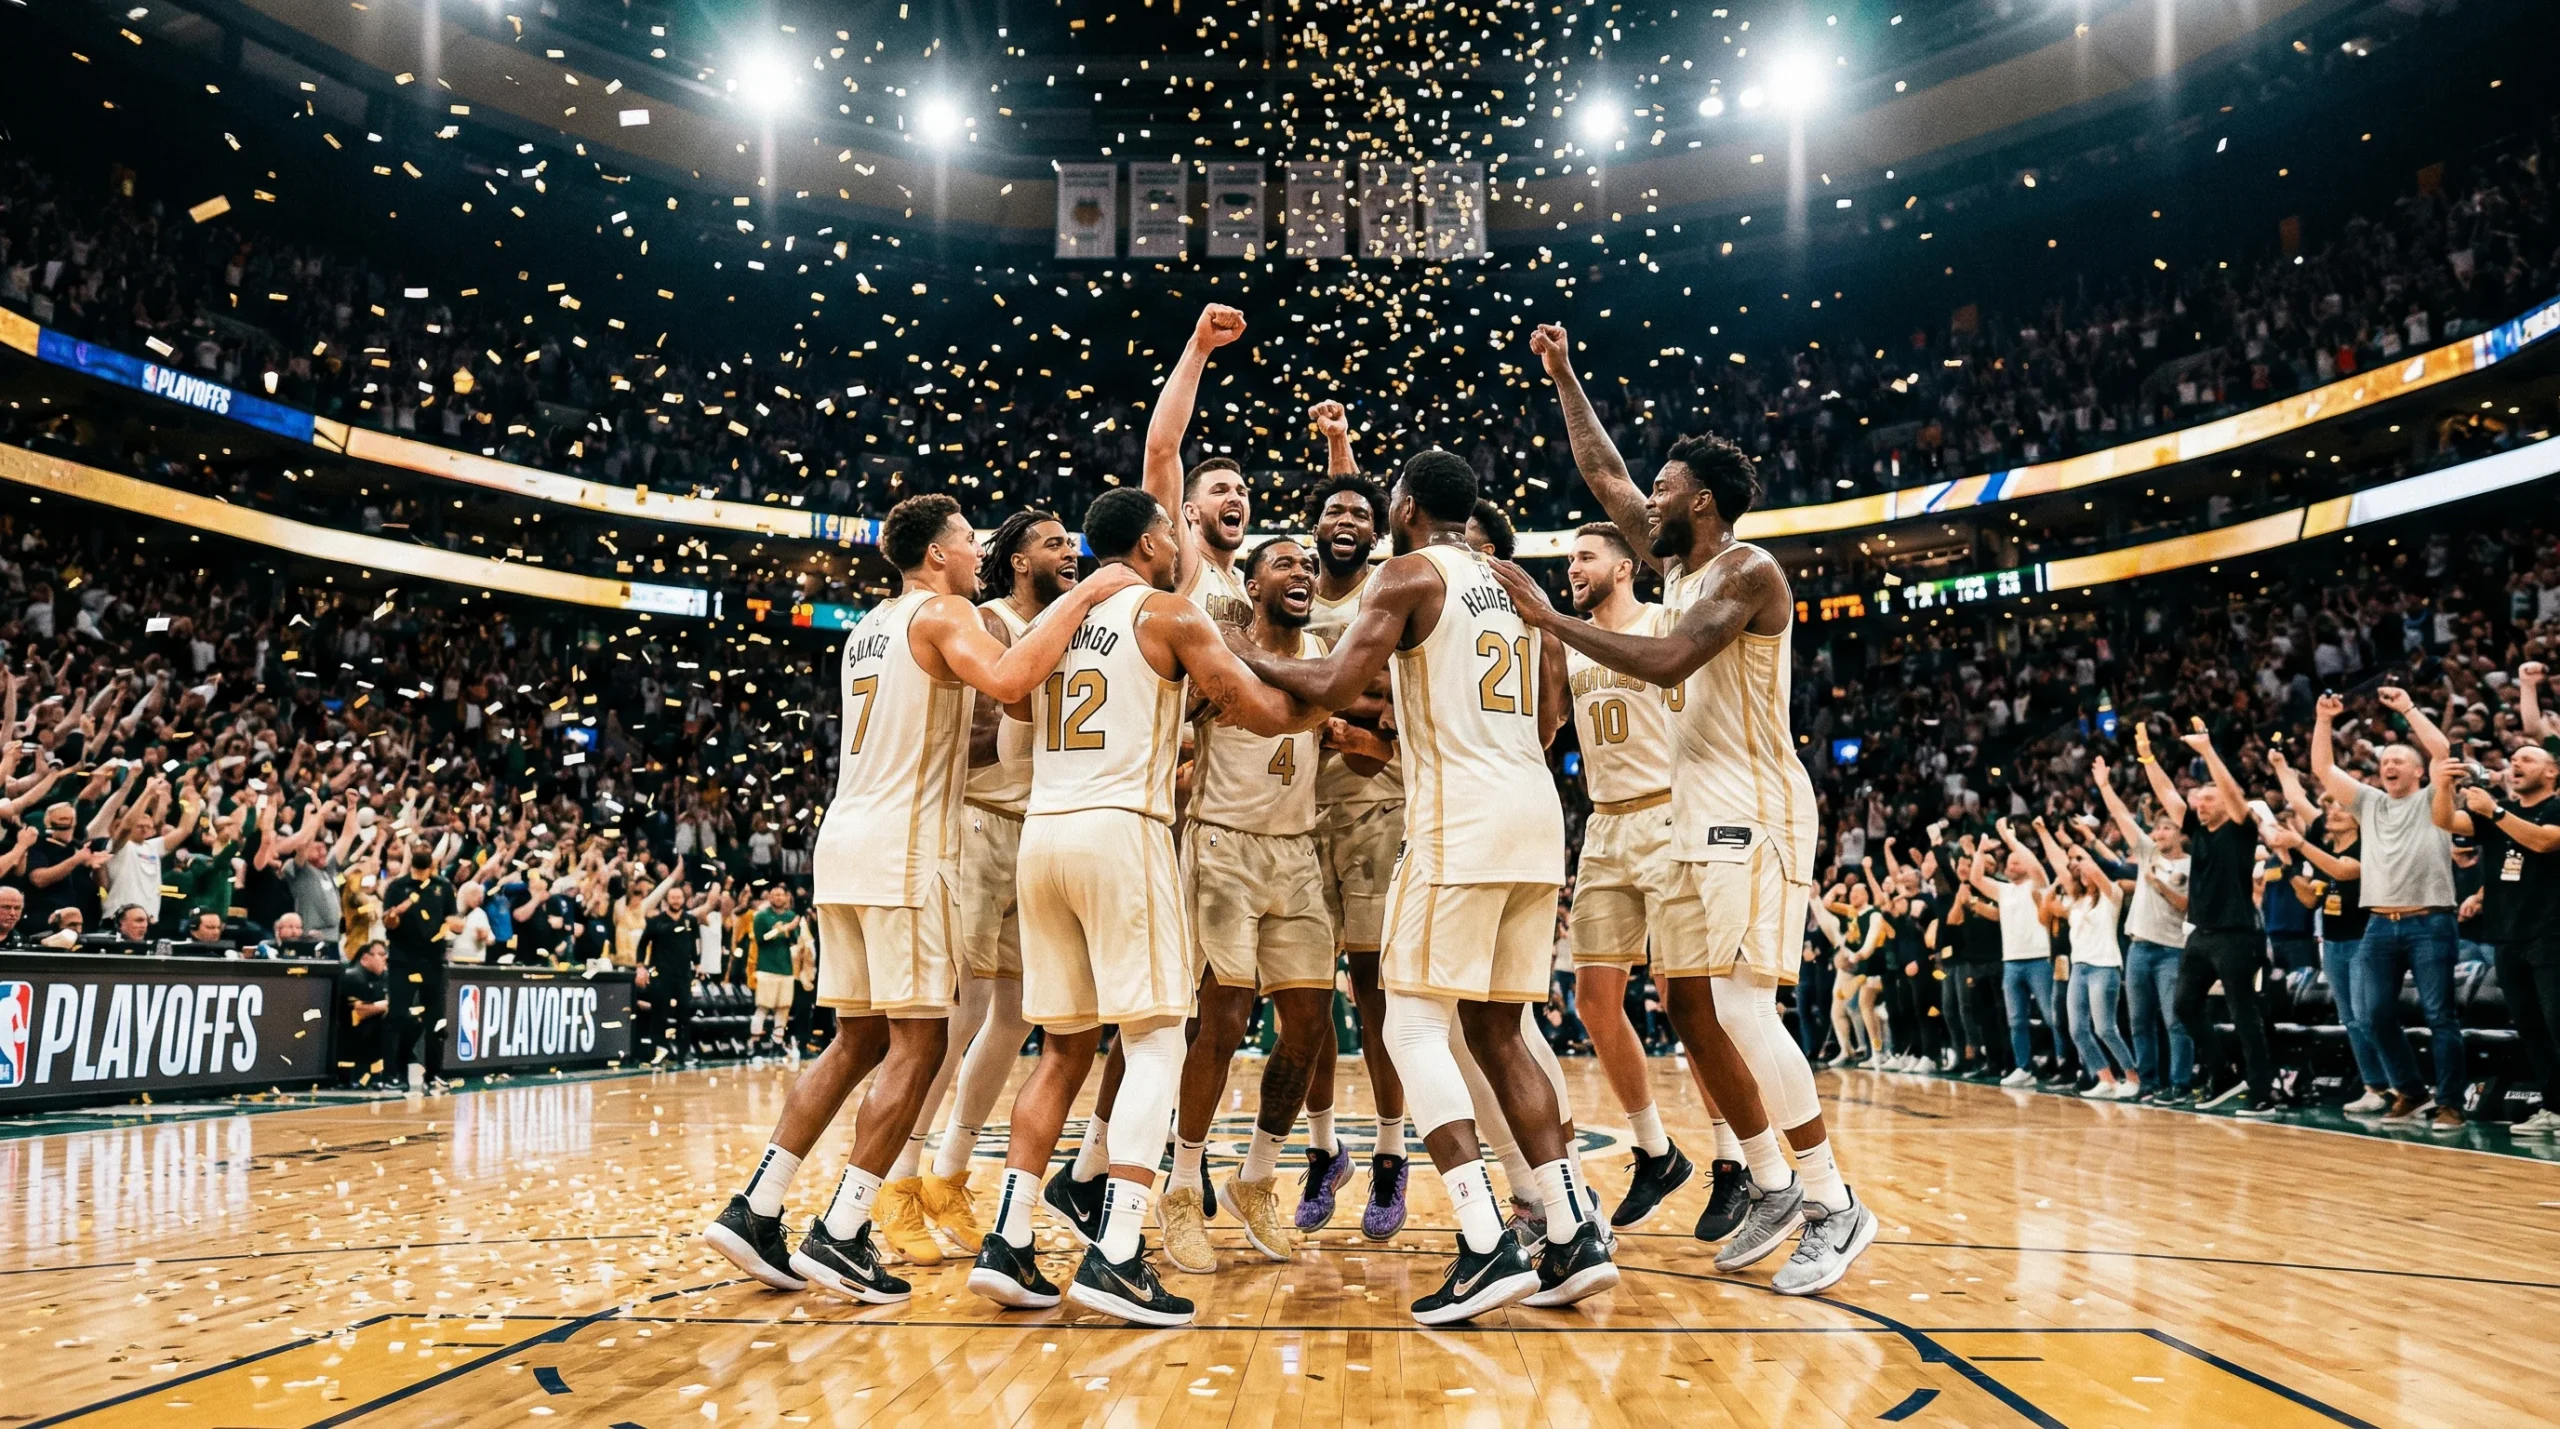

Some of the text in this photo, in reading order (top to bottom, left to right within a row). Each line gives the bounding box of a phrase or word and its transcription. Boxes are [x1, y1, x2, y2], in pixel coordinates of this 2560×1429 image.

[155, 367, 232, 415] PLAYOFFS
[1066, 624, 1119, 657] ONGO
[1475, 629, 1534, 717] 21
[850, 673, 879, 755] 7
[1045, 668, 1108, 752] 12
[1588, 698, 1629, 746] 10
[1267, 737, 1296, 786] 4
[35, 983, 263, 1084] PLAYOFFS
[480, 986, 597, 1059] PLAYOFFS
